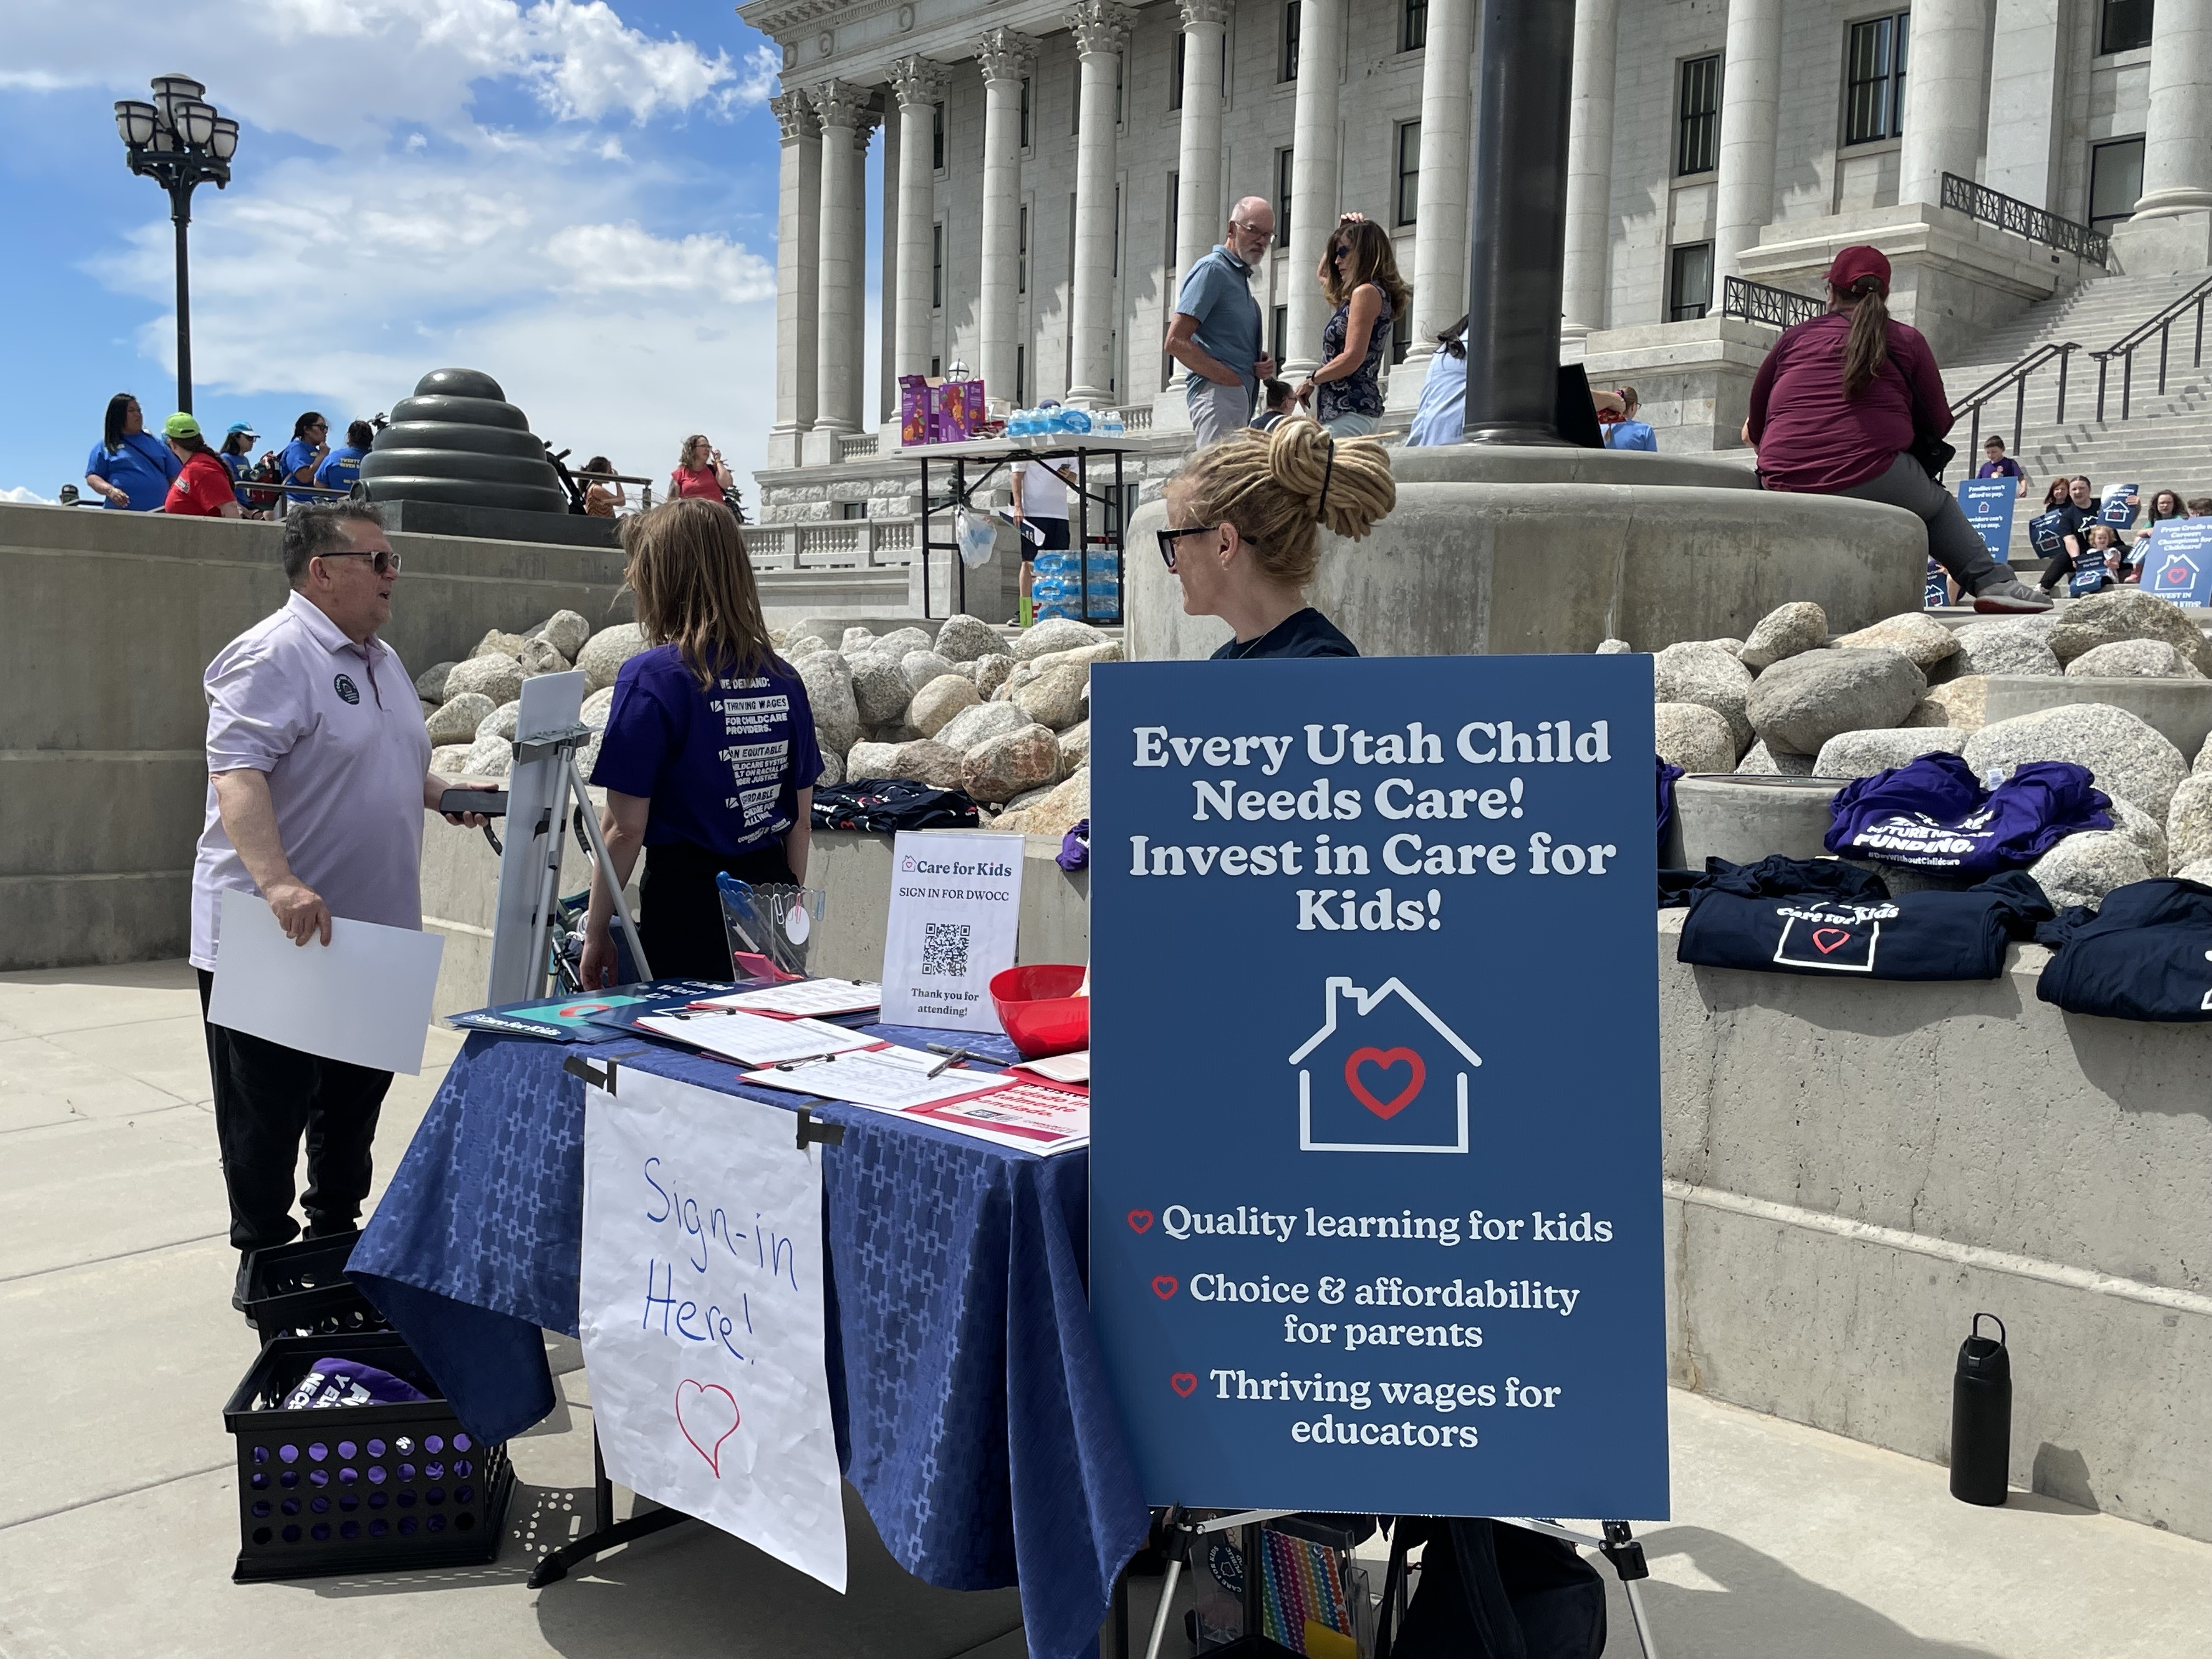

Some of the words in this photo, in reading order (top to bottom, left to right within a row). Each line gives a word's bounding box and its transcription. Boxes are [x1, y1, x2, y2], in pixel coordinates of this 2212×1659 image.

[726, 701, 756, 712] THRIVING
[759, 698, 787, 709] WAGES
[725, 716, 741, 725] FOR
[741, 713, 788, 725] CHILDCARE
[726, 724, 771, 735] PROVIDERS.
[742, 744, 783, 757] EQUITABLE
[1133, 726, 1293, 775] Every
[1304, 722, 1444, 765] Utah
[1457, 720, 1611, 764] Child
[746, 769, 755, 777] ON
[756, 766, 779, 776] RACIAL
[1193, 777, 1362, 821] Needs
[1375, 777, 1523, 820] Care!
[1853, 833, 1975, 853] FUNDING.
[1130, 836, 1303, 876] Invest
[1314, 834, 1370, 875] in
[1383, 833, 1516, 875] Care
[1529, 832, 1617, 875] for
[1867, 851, 1960, 866] #DayWithoutChildcare
[917, 860, 950, 875] Care
[953, 861, 975, 876] for
[977, 861, 1012, 877] Kids
[899, 887, 926, 898] SIGN
[928, 888, 940, 898] IN
[942, 889, 964, 899] FOR
[966, 890, 1009, 901] DWOCC
[1296, 888, 1441, 931] Kids!
[1776, 907, 1824, 922] Care
[911, 988, 943, 1001] Thank
[943, 991, 963, 1002] you
[964, 991, 979, 1001] for
[917, 1005, 968, 1018] attending!
[644, 1157, 798, 1291] Sign-in
[1163, 1205, 1297, 1243] Quality
[1305, 1207, 1460, 1246] learning
[1469, 1210, 1525, 1240] for
[1532, 1211, 1613, 1242] kids
[1190, 1273, 1309, 1304] Choice
[1318, 1276, 1346, 1304] &
[1355, 1277, 1581, 1316] affordability
[643, 1259, 754, 1365] Here!
[1284, 1314, 1337, 1343] for
[1345, 1323, 1483, 1351] parents
[1210, 1369, 1372, 1410] Thriving
[1378, 1383, 1496, 1412] wages
[1505, 1376, 1561, 1408] for
[1291, 1414, 1478, 1448] educators
[1209, 1545, 1220, 1562] KIDS
[1225, 1547, 1243, 1573] PUBLIC
[1210, 1563, 1222, 1579] FOR
[1221, 1579, 1242, 1593] CARE
